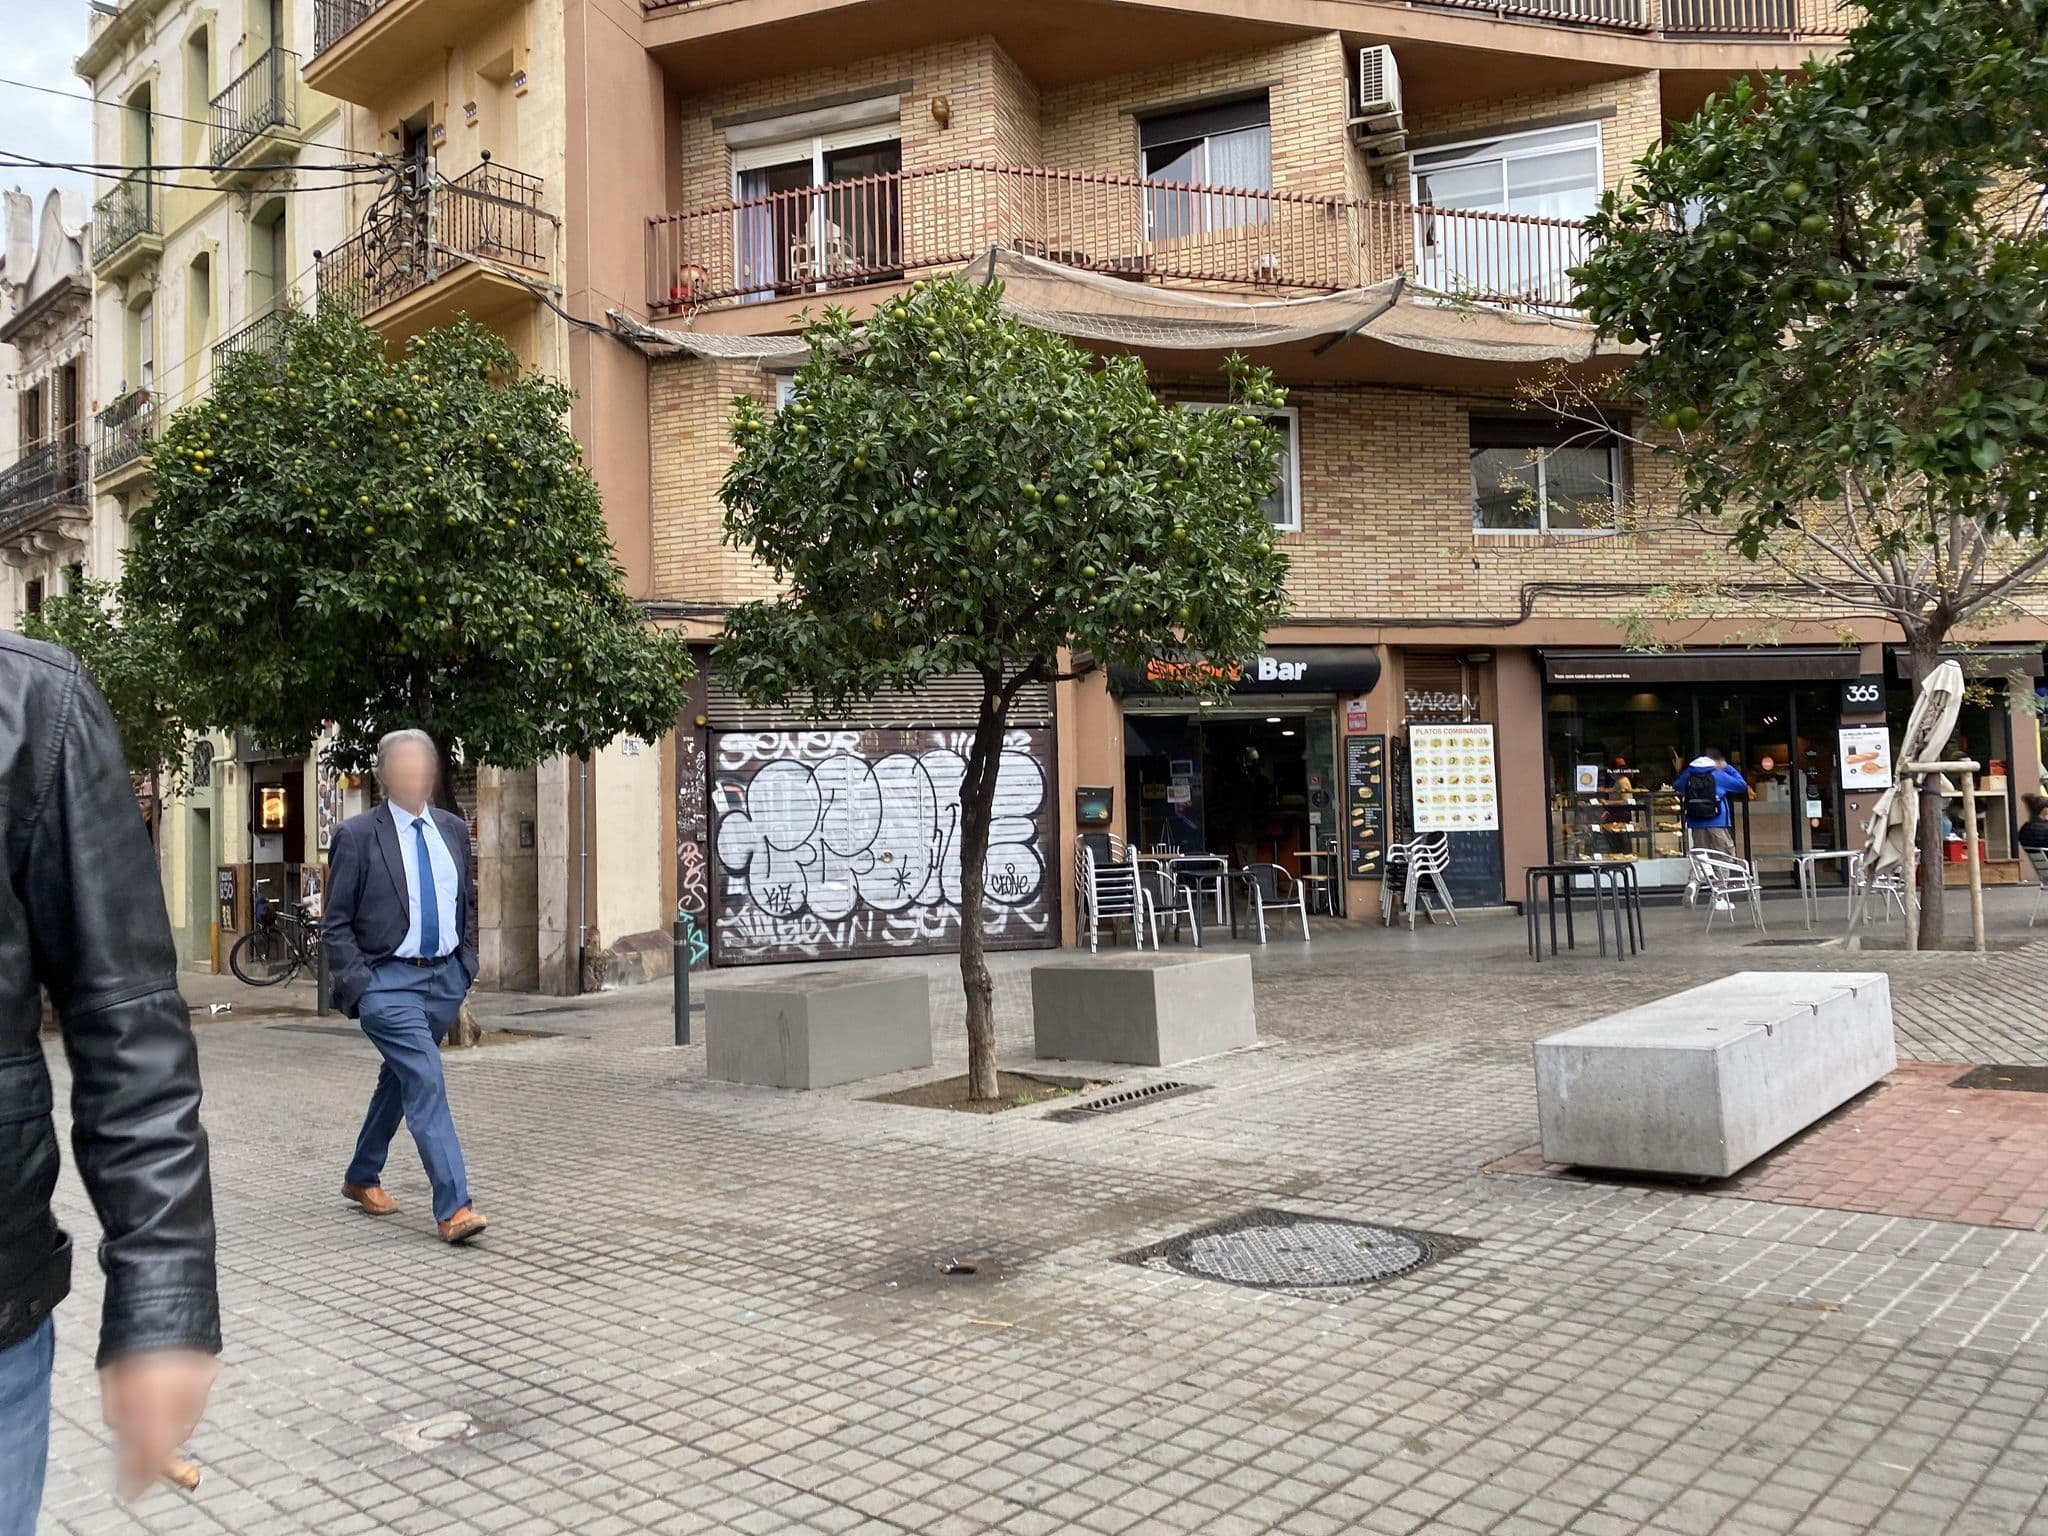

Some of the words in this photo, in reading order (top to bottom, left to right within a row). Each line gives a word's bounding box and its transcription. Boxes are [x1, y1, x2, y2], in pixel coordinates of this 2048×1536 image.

[1258, 657, 1307, 681] Bar
[1846, 685, 1879, 702] 365
[1443, 727, 1488, 735] COMBINADOS
